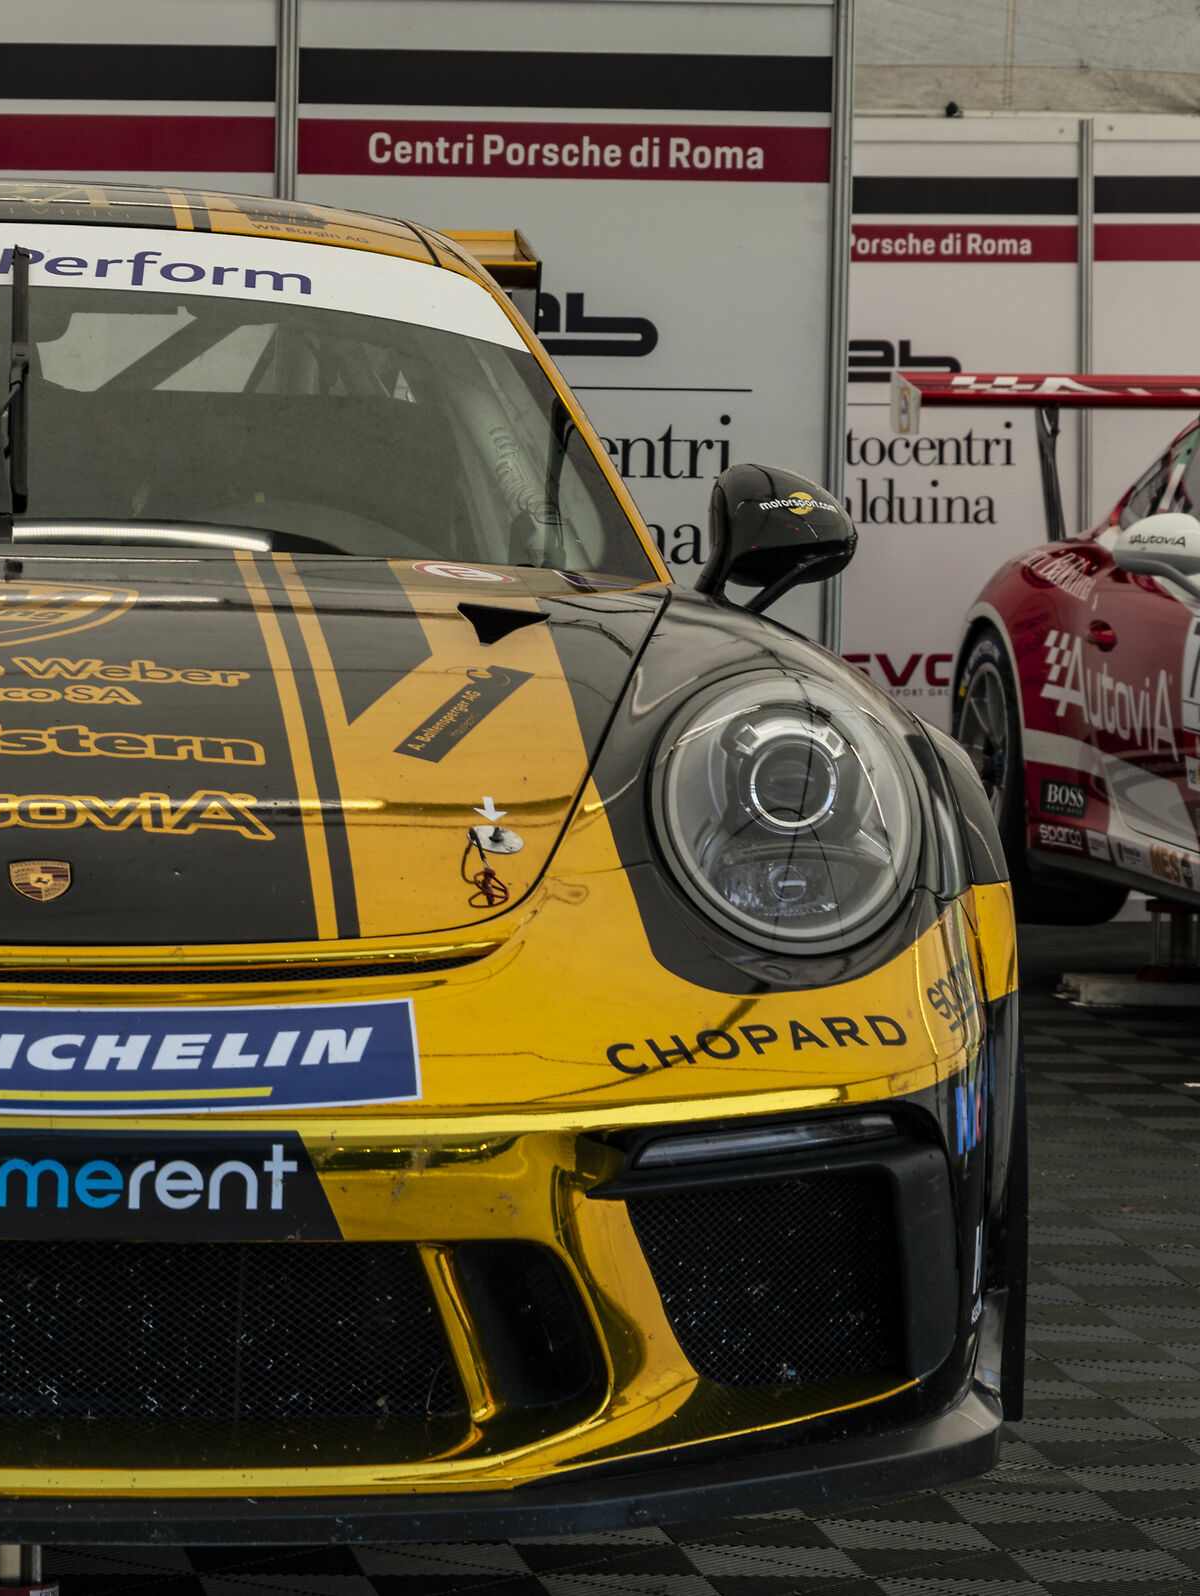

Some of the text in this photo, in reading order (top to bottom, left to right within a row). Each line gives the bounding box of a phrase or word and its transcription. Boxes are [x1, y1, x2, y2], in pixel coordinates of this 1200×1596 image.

[367, 131, 765, 170] Centri Porsche di Roma
[940, 232, 962, 255] di
[967, 233, 1033, 255] Roma
[758, 498, 840, 514] motorsport.com
[11, 655, 252, 688] Weber
[1047, 783, 1086, 809] BOSS
[1039, 824, 1083, 847] sparco
[605, 1014, 909, 1076] CHOPARD
